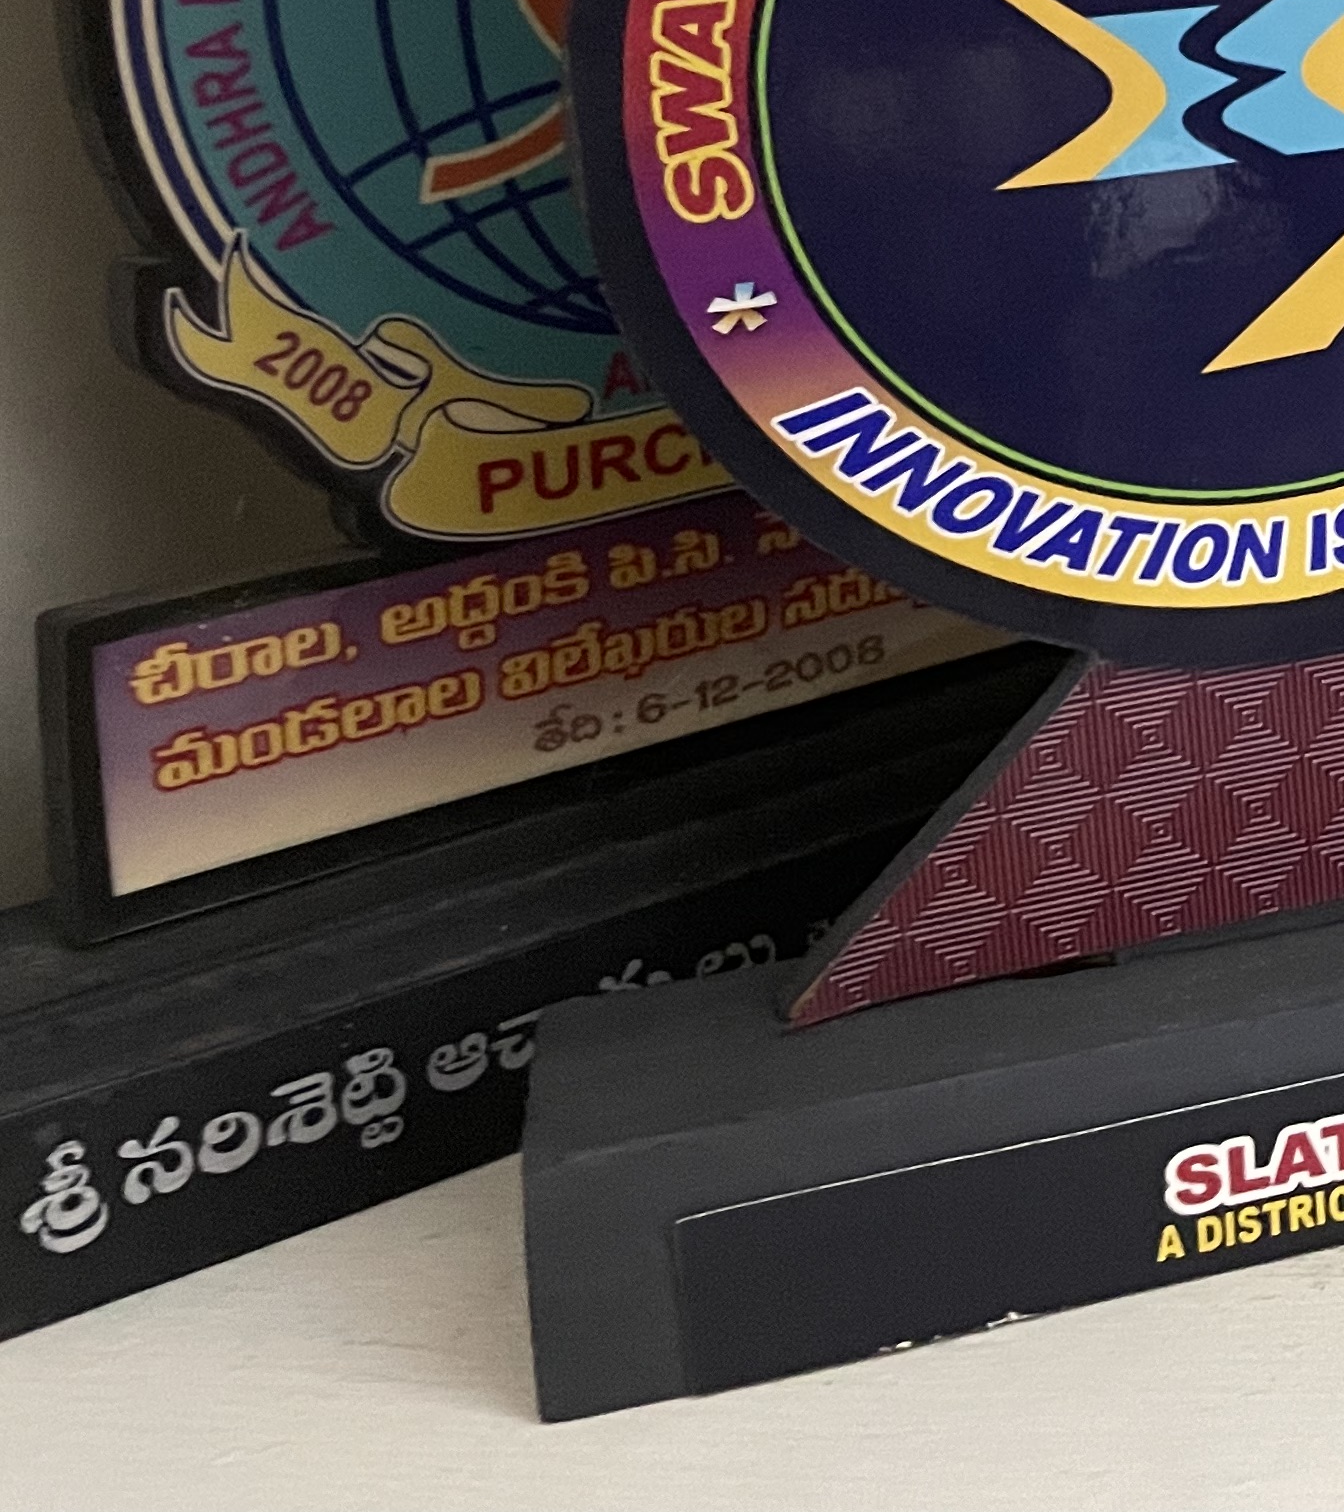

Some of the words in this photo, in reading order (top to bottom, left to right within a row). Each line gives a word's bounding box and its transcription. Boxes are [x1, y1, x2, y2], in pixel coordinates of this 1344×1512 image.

[187, 21, 338, 253] ANDHRA
[254, 331, 373, 423] 2008
[478, 422, 713, 514] PURC
[774, 386, 1284, 590] INNOVATION
[380, 550, 592, 651] అద్దంకి
[151, 668, 487, 791] మండలాల
[637, 635, 886, 726] 6-12-2008
[20, 1140, 109, 1253] శ్రీ
[1156, 1225, 1185, 1262] A
